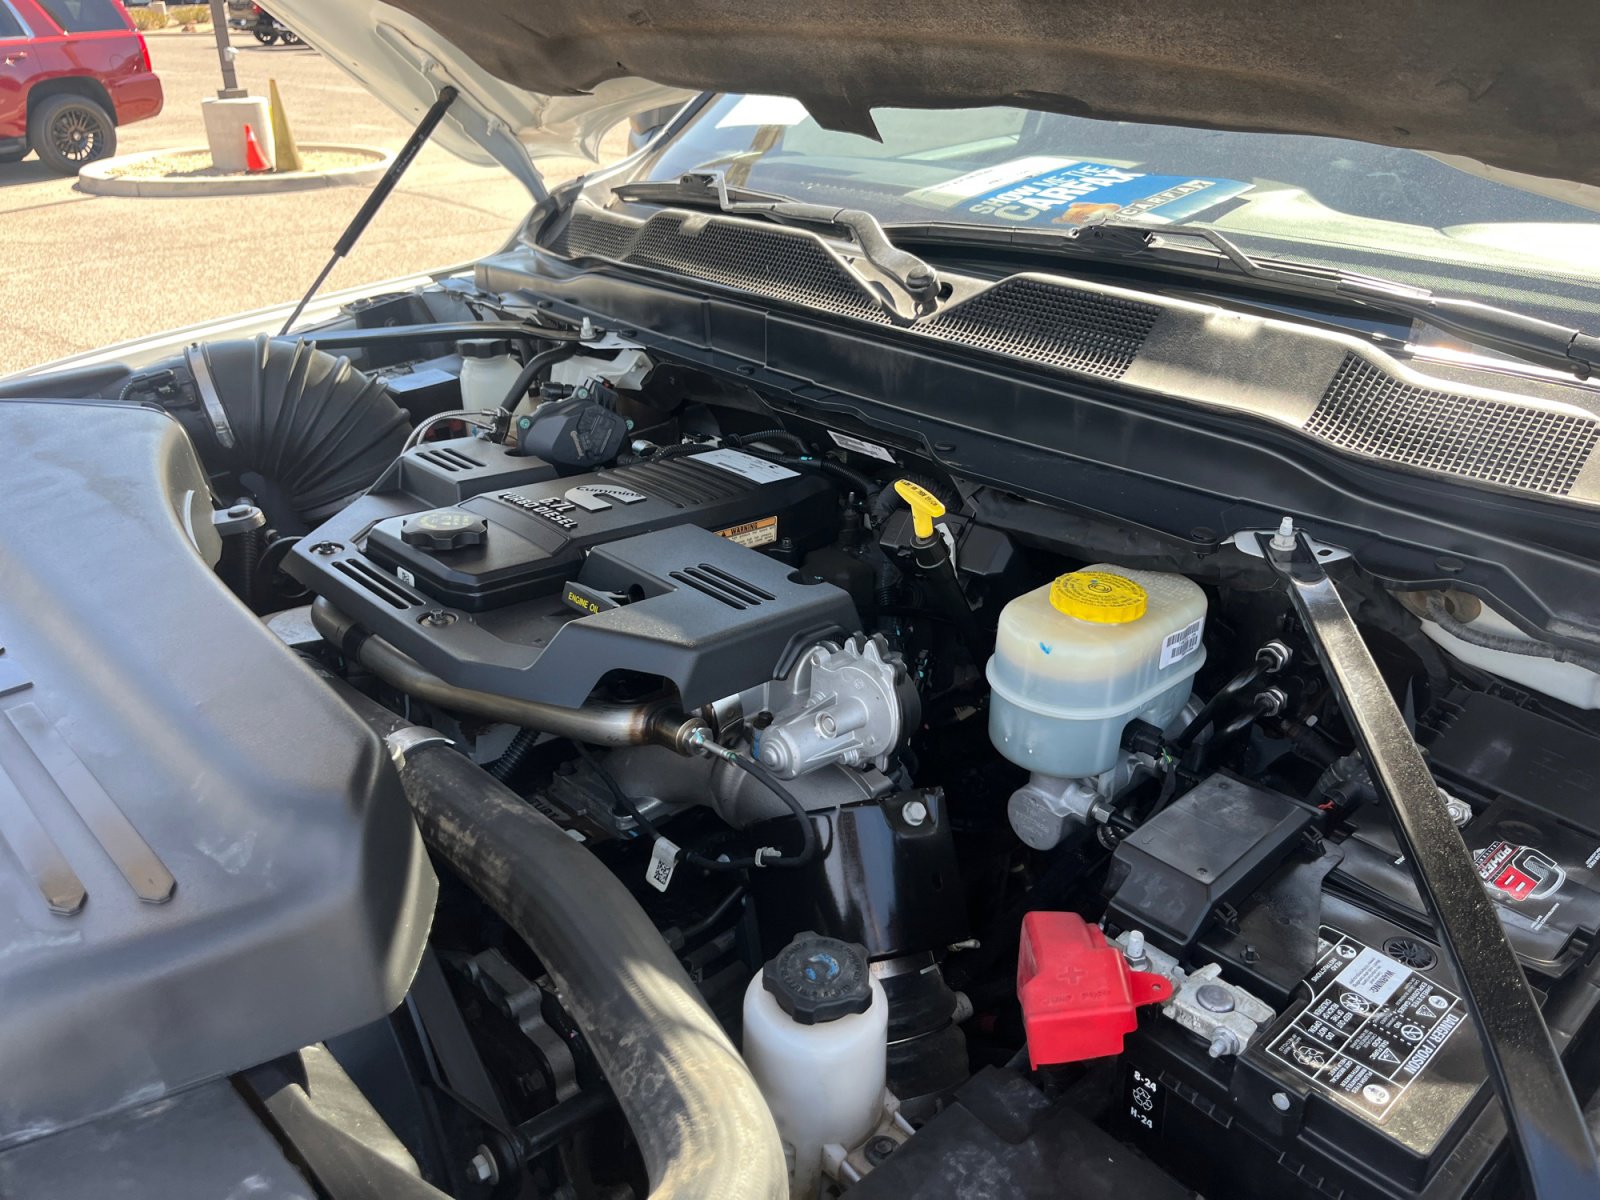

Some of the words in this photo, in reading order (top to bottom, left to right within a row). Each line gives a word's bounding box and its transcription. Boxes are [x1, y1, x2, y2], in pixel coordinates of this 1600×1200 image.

[969, 185, 1041, 214] SHOW
[1032, 175, 1065, 187] ME
[1061, 165, 1109, 178] THE
[994, 168, 1147, 221] CARFAX
[1118, 180, 1216, 216] CARFAX
[498, 491, 540, 510] TURBO
[533, 505, 578, 531] DIESEL
[730, 522, 758, 535] WARNING
[568, 591, 589, 610] ENGINE
[589, 603, 600, 615] OIL
[1479, 844, 1513, 879] POWER
[1310, 957, 1336, 981] INSTRUCTIONS
[1316, 1026, 1328, 1036] NOT
[1429, 1013, 1459, 1042] DANGER
[1403, 1044, 1433, 1074] POISON
[1134, 1070, 1156, 1092] B-24
[1131, 1107, 1153, 1129] H-24
